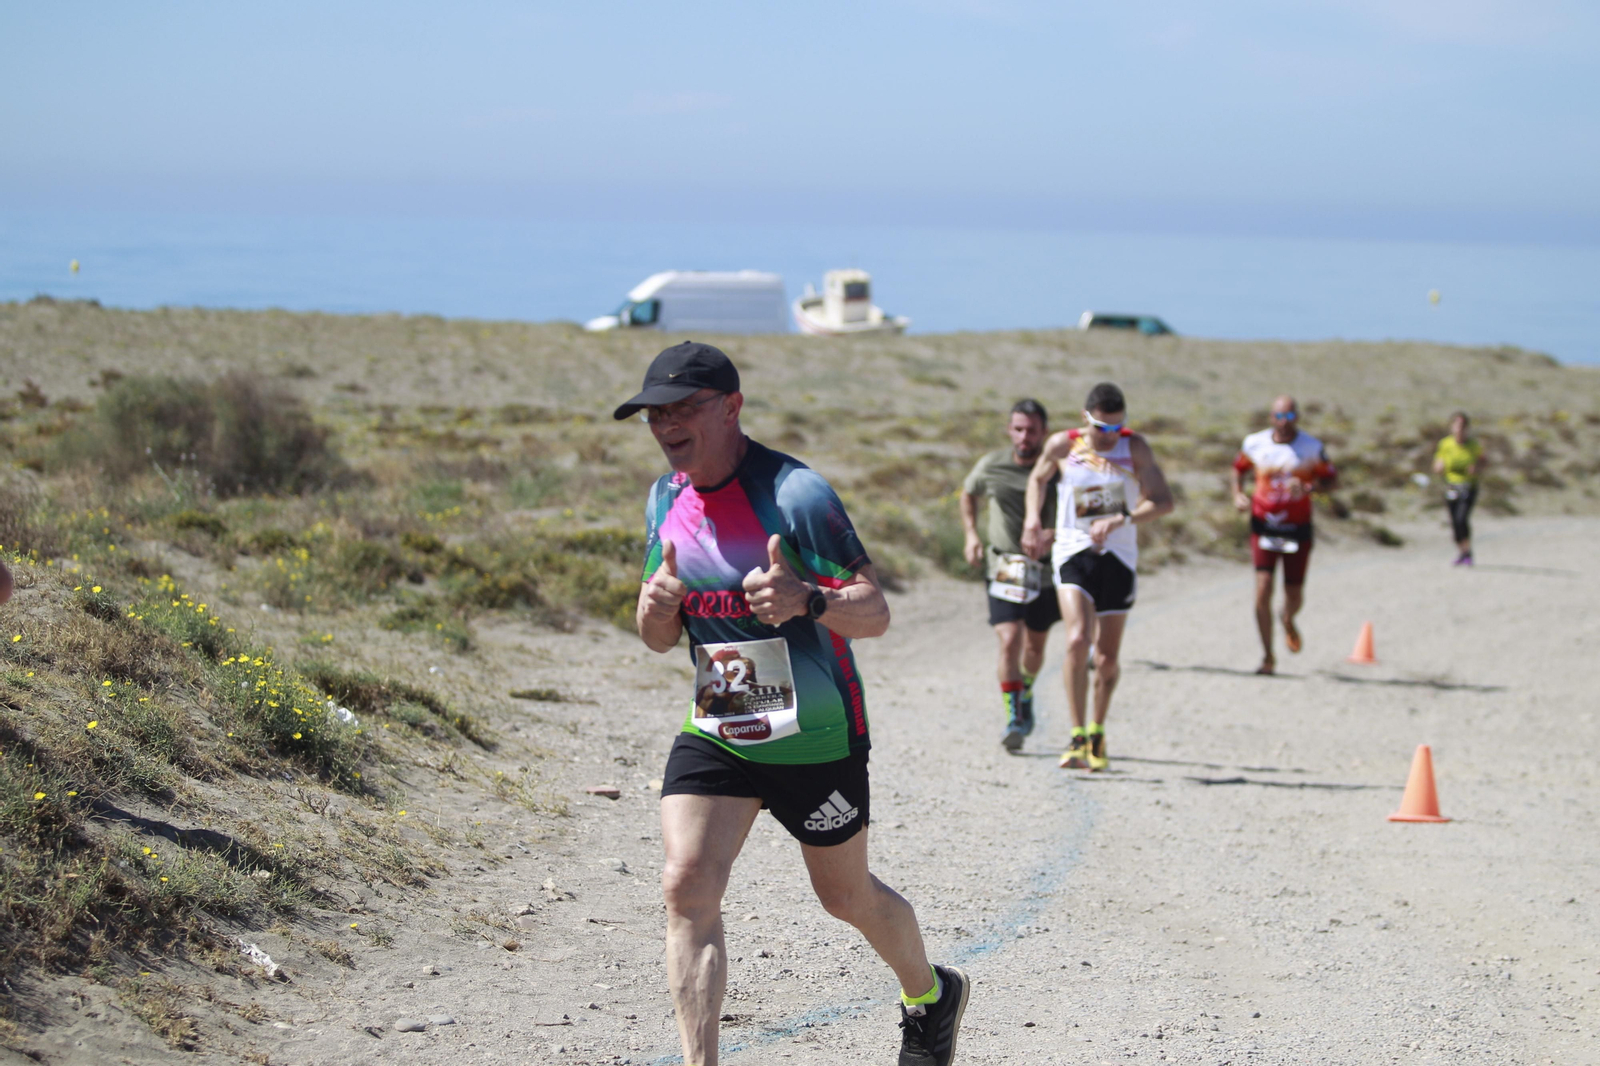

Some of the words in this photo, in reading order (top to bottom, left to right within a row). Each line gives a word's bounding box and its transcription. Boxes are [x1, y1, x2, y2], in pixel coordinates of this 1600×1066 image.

[711, 659, 750, 694] 32
[838, 657, 854, 682] DEL
[847, 681, 867, 736] ALQUIAN
[804, 807, 859, 831] adidas
